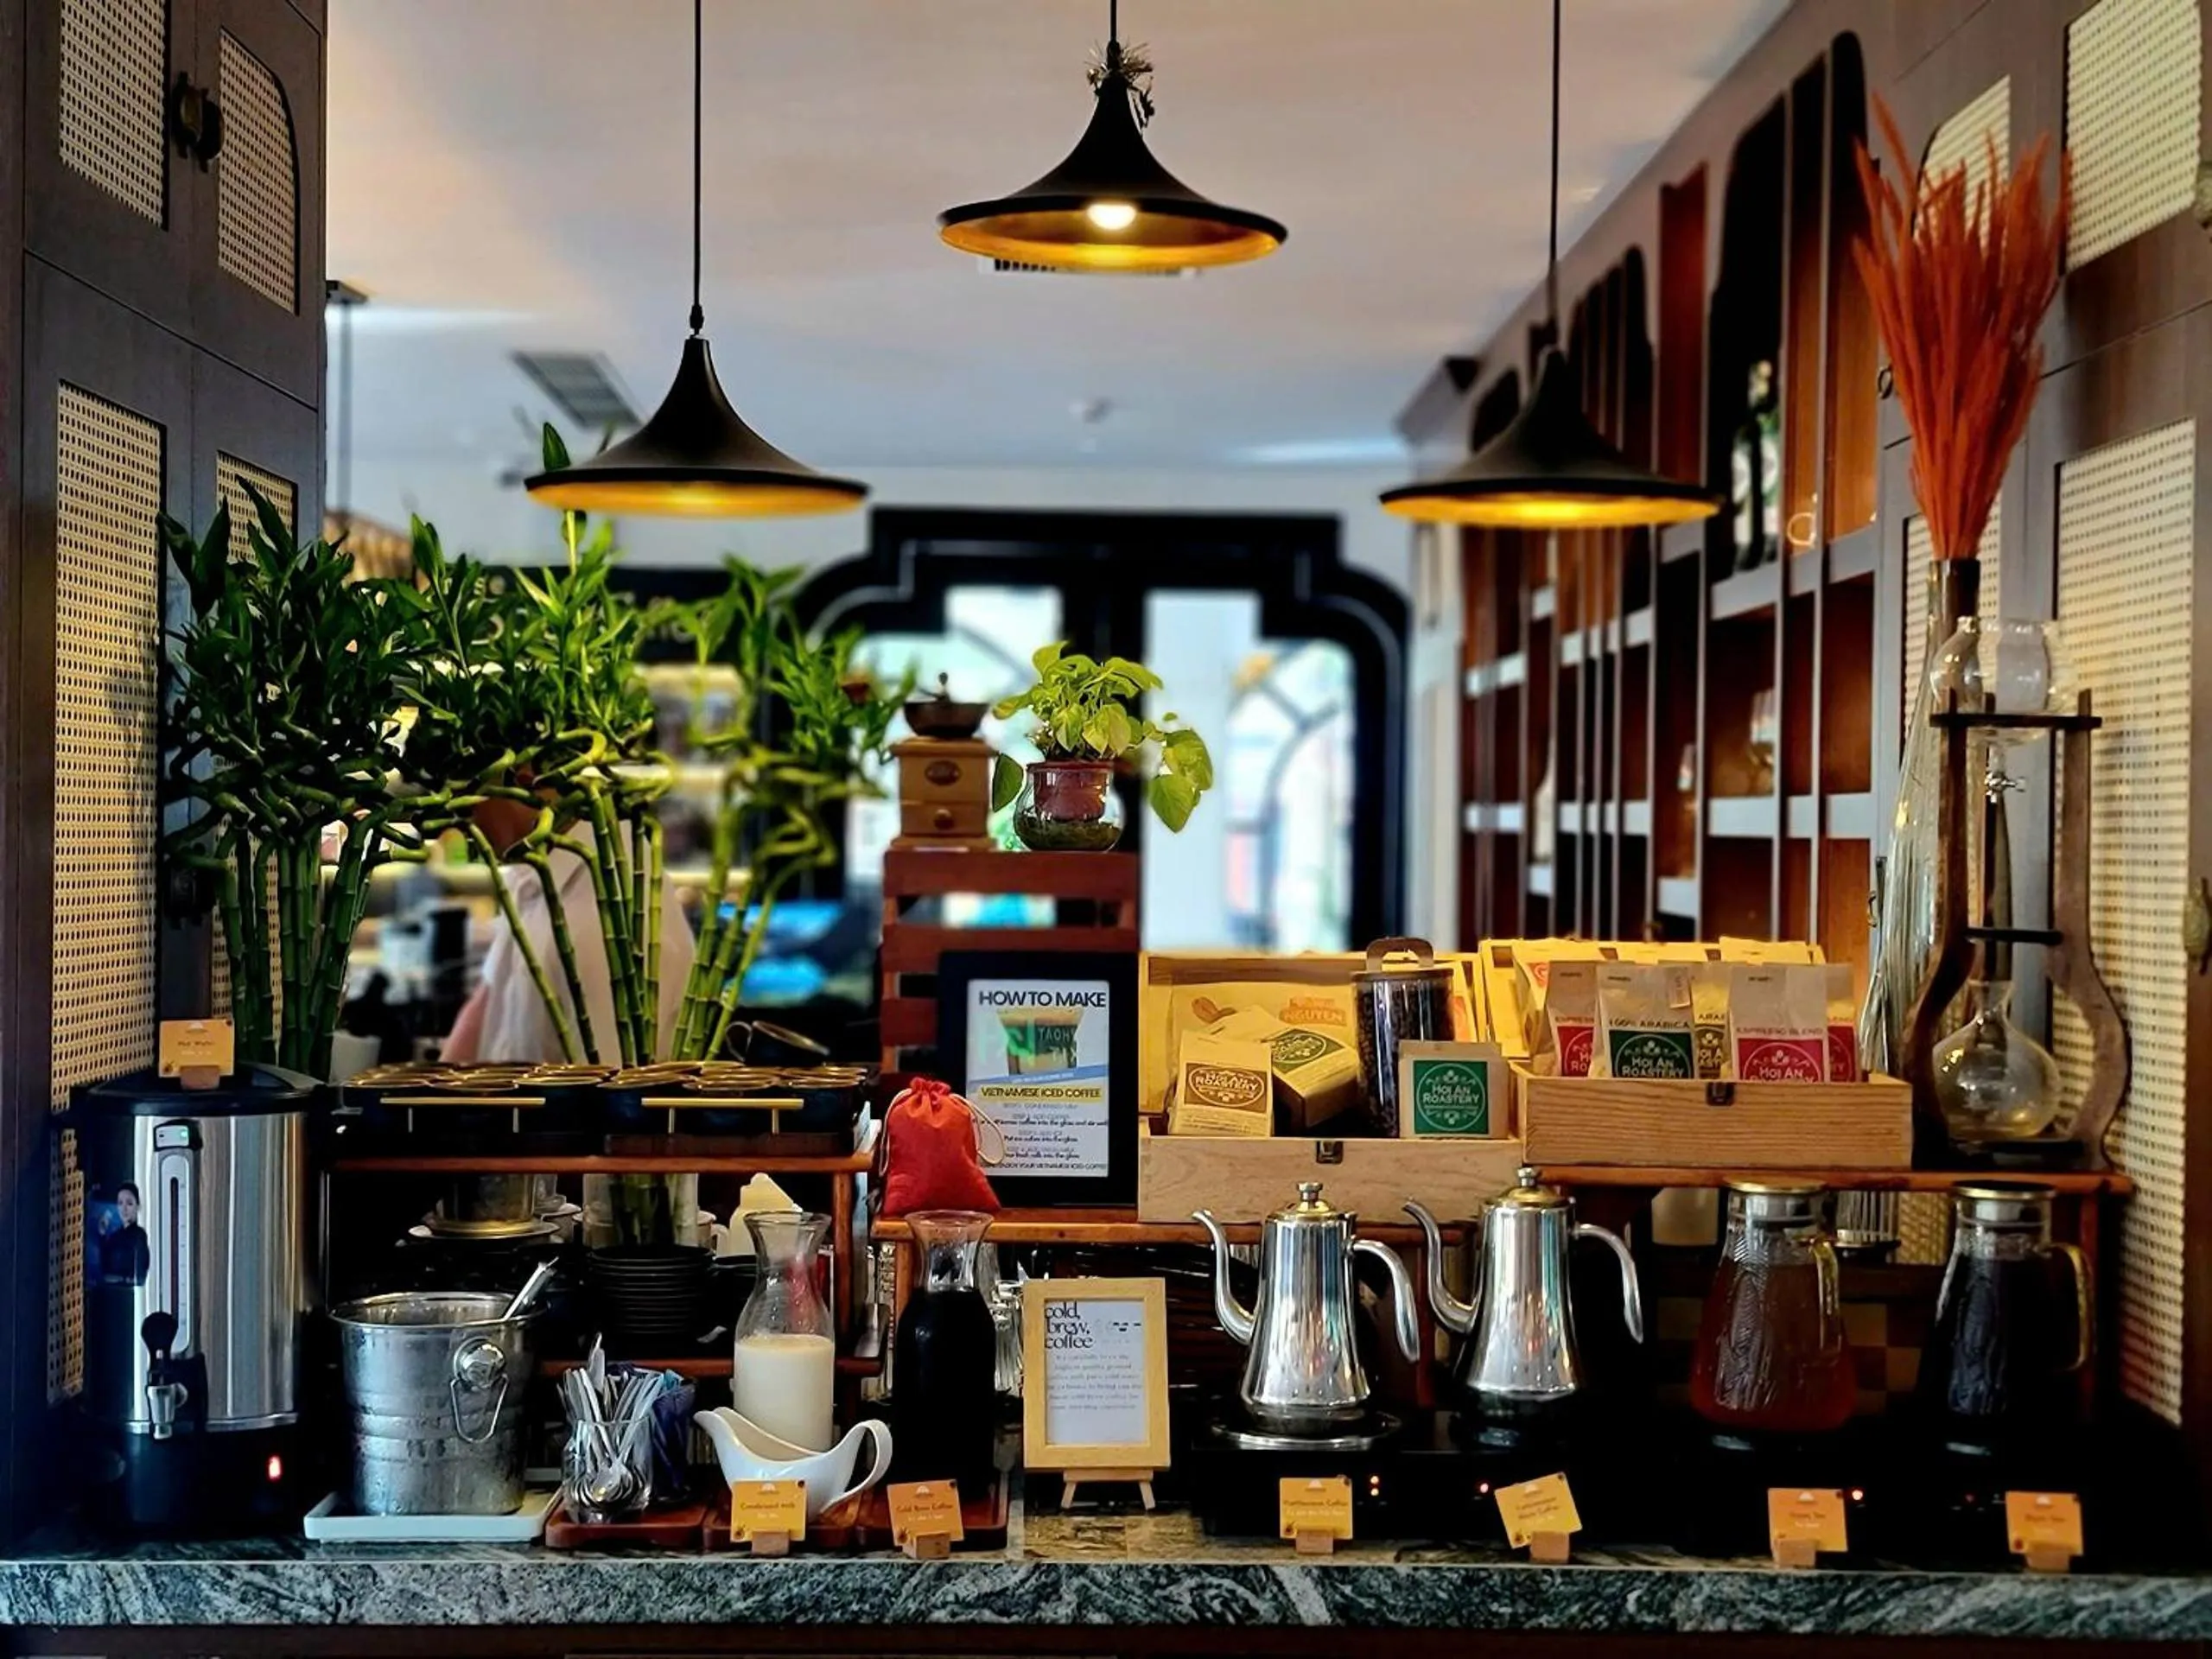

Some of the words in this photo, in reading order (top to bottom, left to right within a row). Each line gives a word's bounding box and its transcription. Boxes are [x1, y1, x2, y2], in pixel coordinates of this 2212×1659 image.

[978, 991, 1026, 1006] HOW
[1027, 991, 1052, 1007] TO
[1056, 992, 1106, 1007] MAKE
[1639, 1020, 1690, 1029] ARABICA
[1621, 1065, 1685, 1077] ROASTERY
[981, 1087, 1039, 1098] VIETNAMESE
[1040, 1088, 1064, 1098] ICED
[1065, 1088, 1102, 1098] COFFEE
[1422, 1092, 1480, 1104] ROASTERY
[1044, 1335, 1094, 1349] coffee
